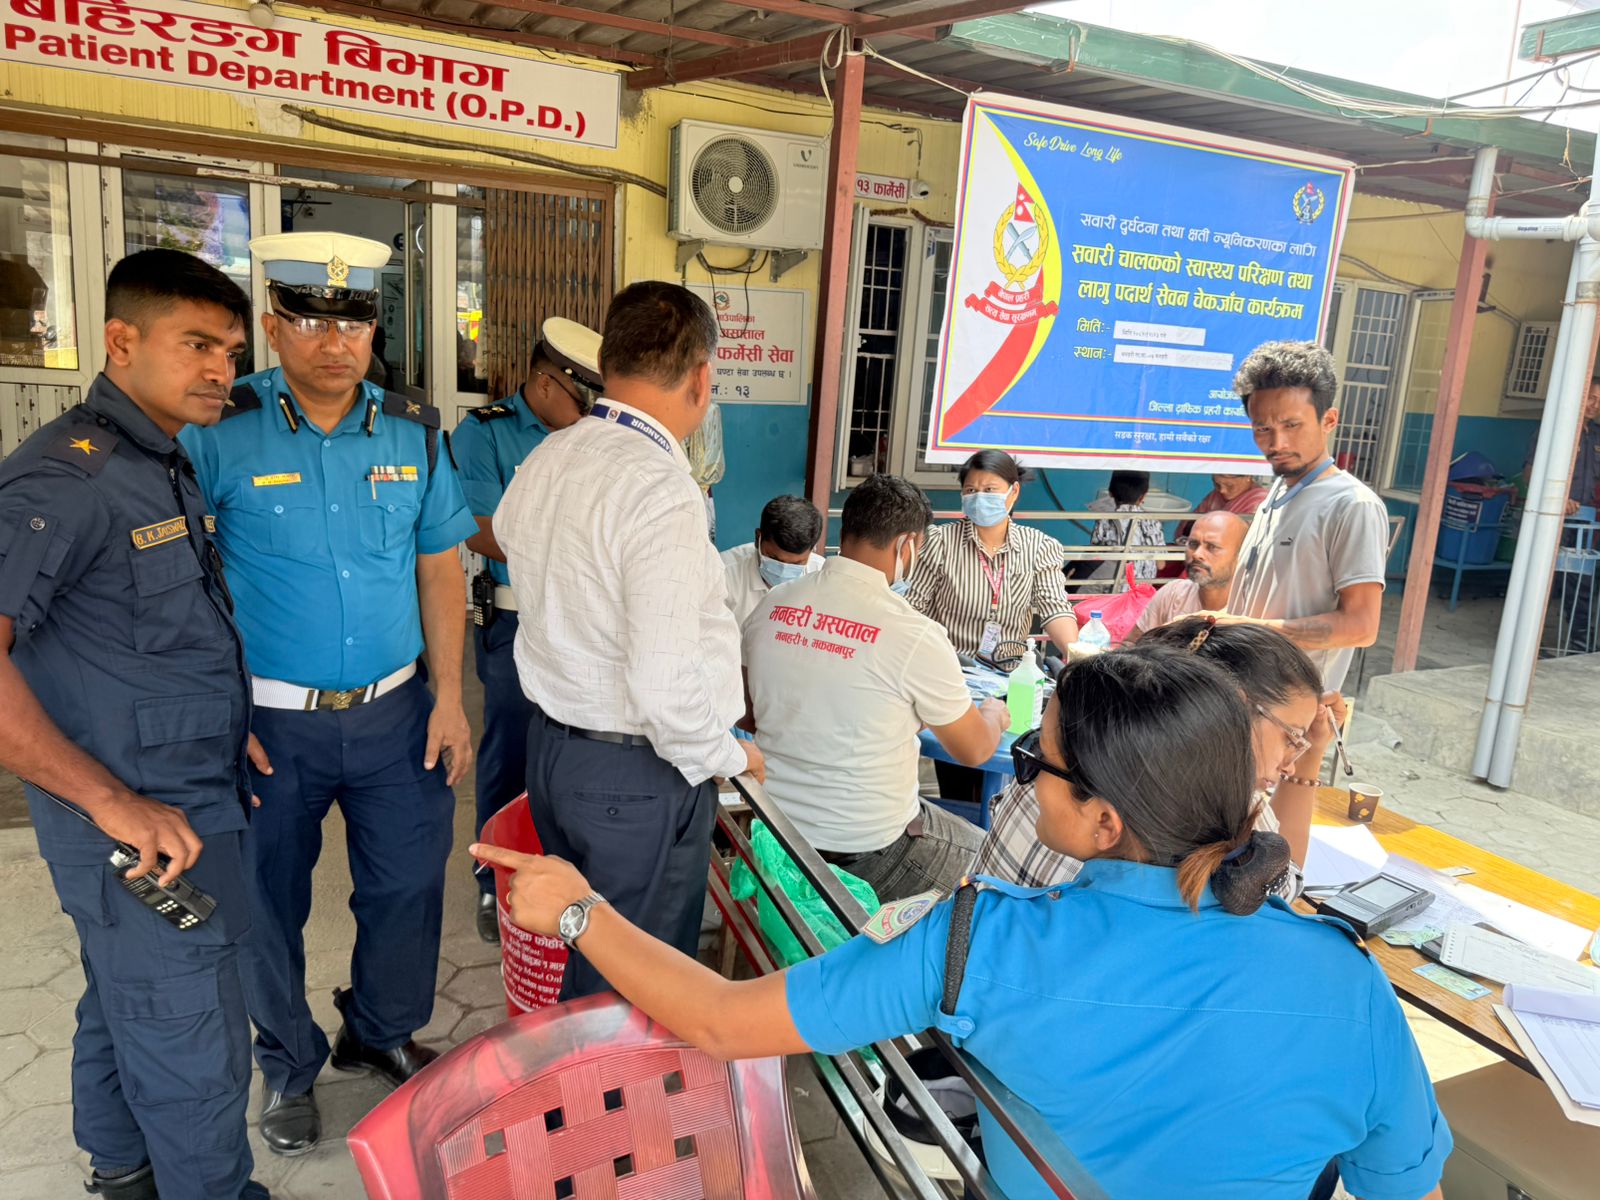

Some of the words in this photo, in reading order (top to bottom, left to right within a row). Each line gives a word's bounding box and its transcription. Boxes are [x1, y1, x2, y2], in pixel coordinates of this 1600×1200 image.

[4, 23, 174, 72] Patient
[187, 47, 435, 111] Department
[446, 91, 587, 138] (O.P.D.)
[324, 30, 510, 92] बिभाग
[1024, 131, 1048, 151] Safe
[1049, 135, 1077, 153] Drive
[1080, 142, 1104, 162] Long
[1105, 145, 1123, 163] Life
[857, 178, 870, 193] १३
[873, 180, 905, 199] फार्मेसी
[1080, 213, 1117, 230] सवारी
[1120, 216, 1159, 235] दुर्घटना
[1162, 224, 1185, 239] तथा
[1188, 228, 1210, 243] क्षती
[1289, 242, 1317, 257] लागि
[1072, 243, 1116, 267] सवारी
[1118, 250, 1183, 273] चालकको
[1238, 260, 1285, 287] परिक्षण
[1287, 272, 1314, 290] तथा
[1078, 279, 1112, 305] लागु
[1115, 282, 1154, 304] पदार्थ
[1156, 283, 1190, 308] सेवन
[1193, 287, 1245, 313] चेकजाँच
[1247, 297, 1305, 320] कार्यक्रम
[768, 345, 795, 363] सेवा
[735, 385, 750, 398] १३
[769, 605, 813, 628] मनहरी
[813, 612, 881, 644] अस्पताल
[812, 638, 856, 660] मकवानपुर
